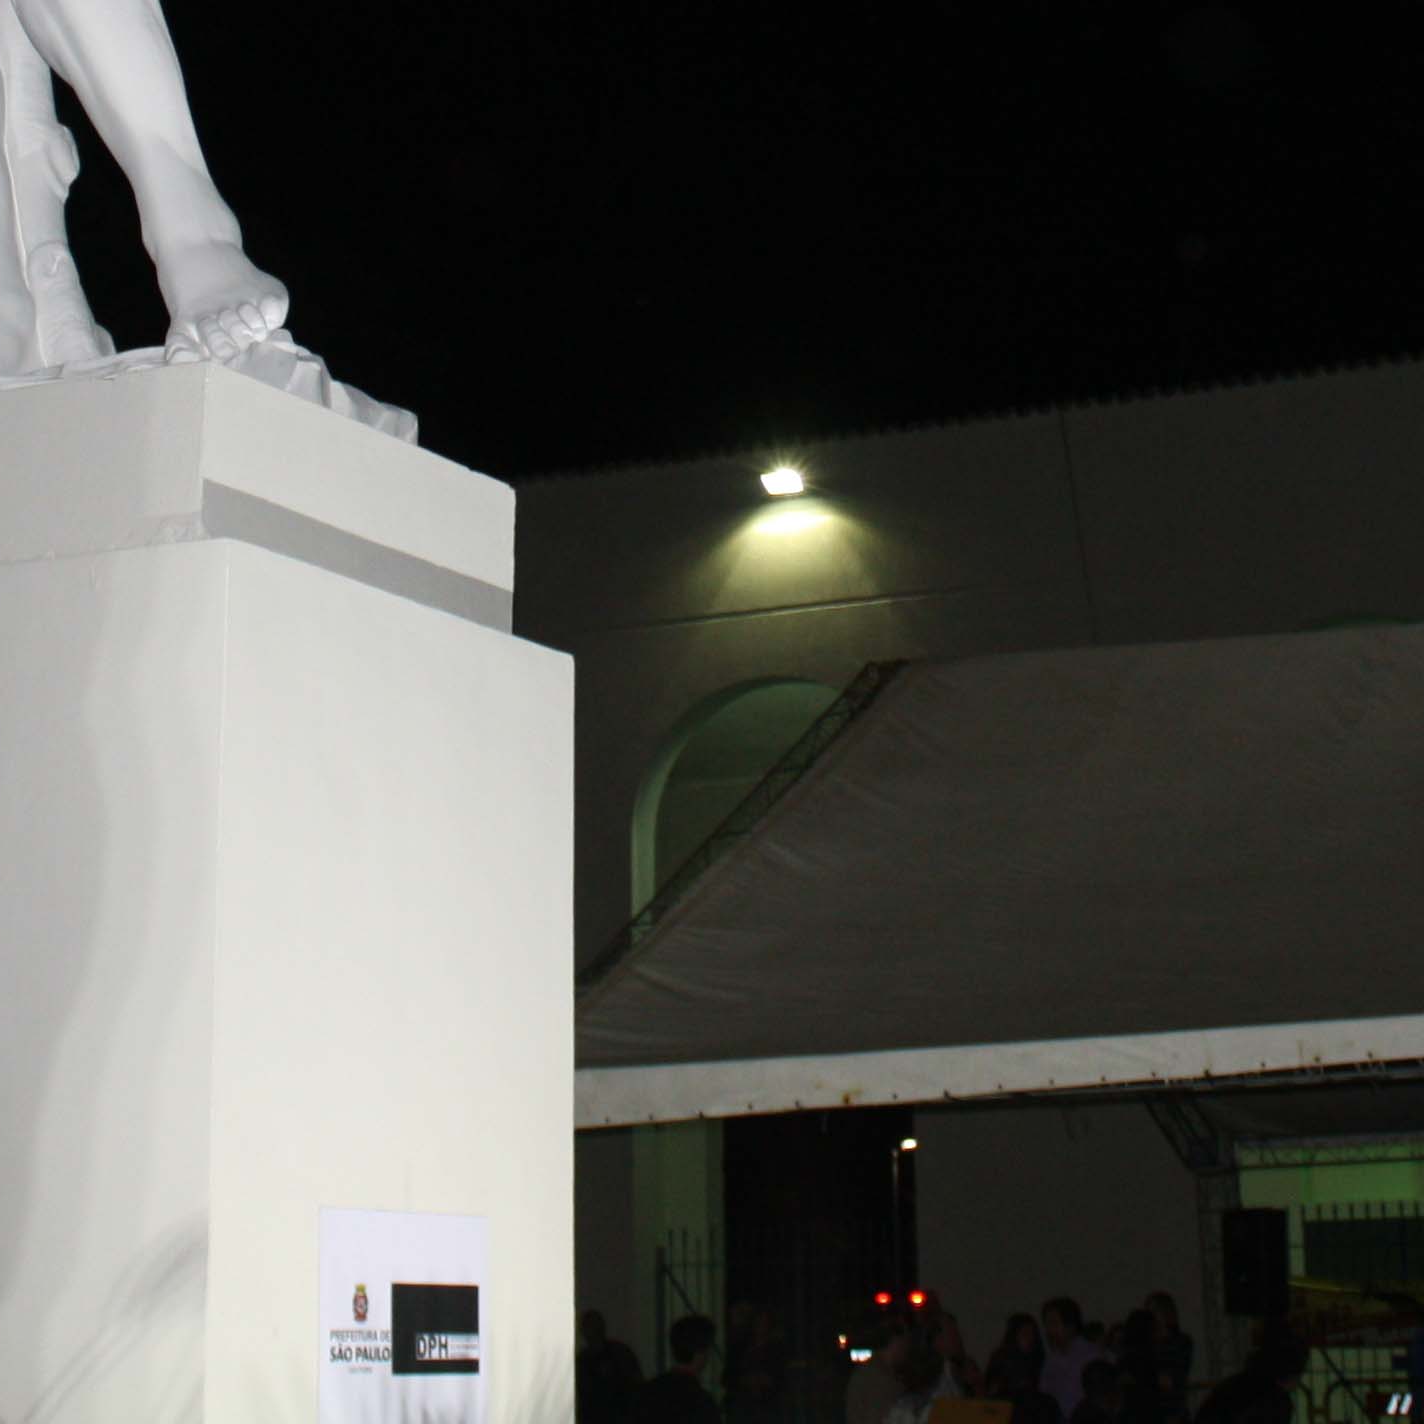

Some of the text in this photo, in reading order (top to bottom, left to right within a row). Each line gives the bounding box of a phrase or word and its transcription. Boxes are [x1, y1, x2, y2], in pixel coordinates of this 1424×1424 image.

[330, 1342, 392, 1362] SÃO PAULO
[416, 1334, 449, 1359] DPH
